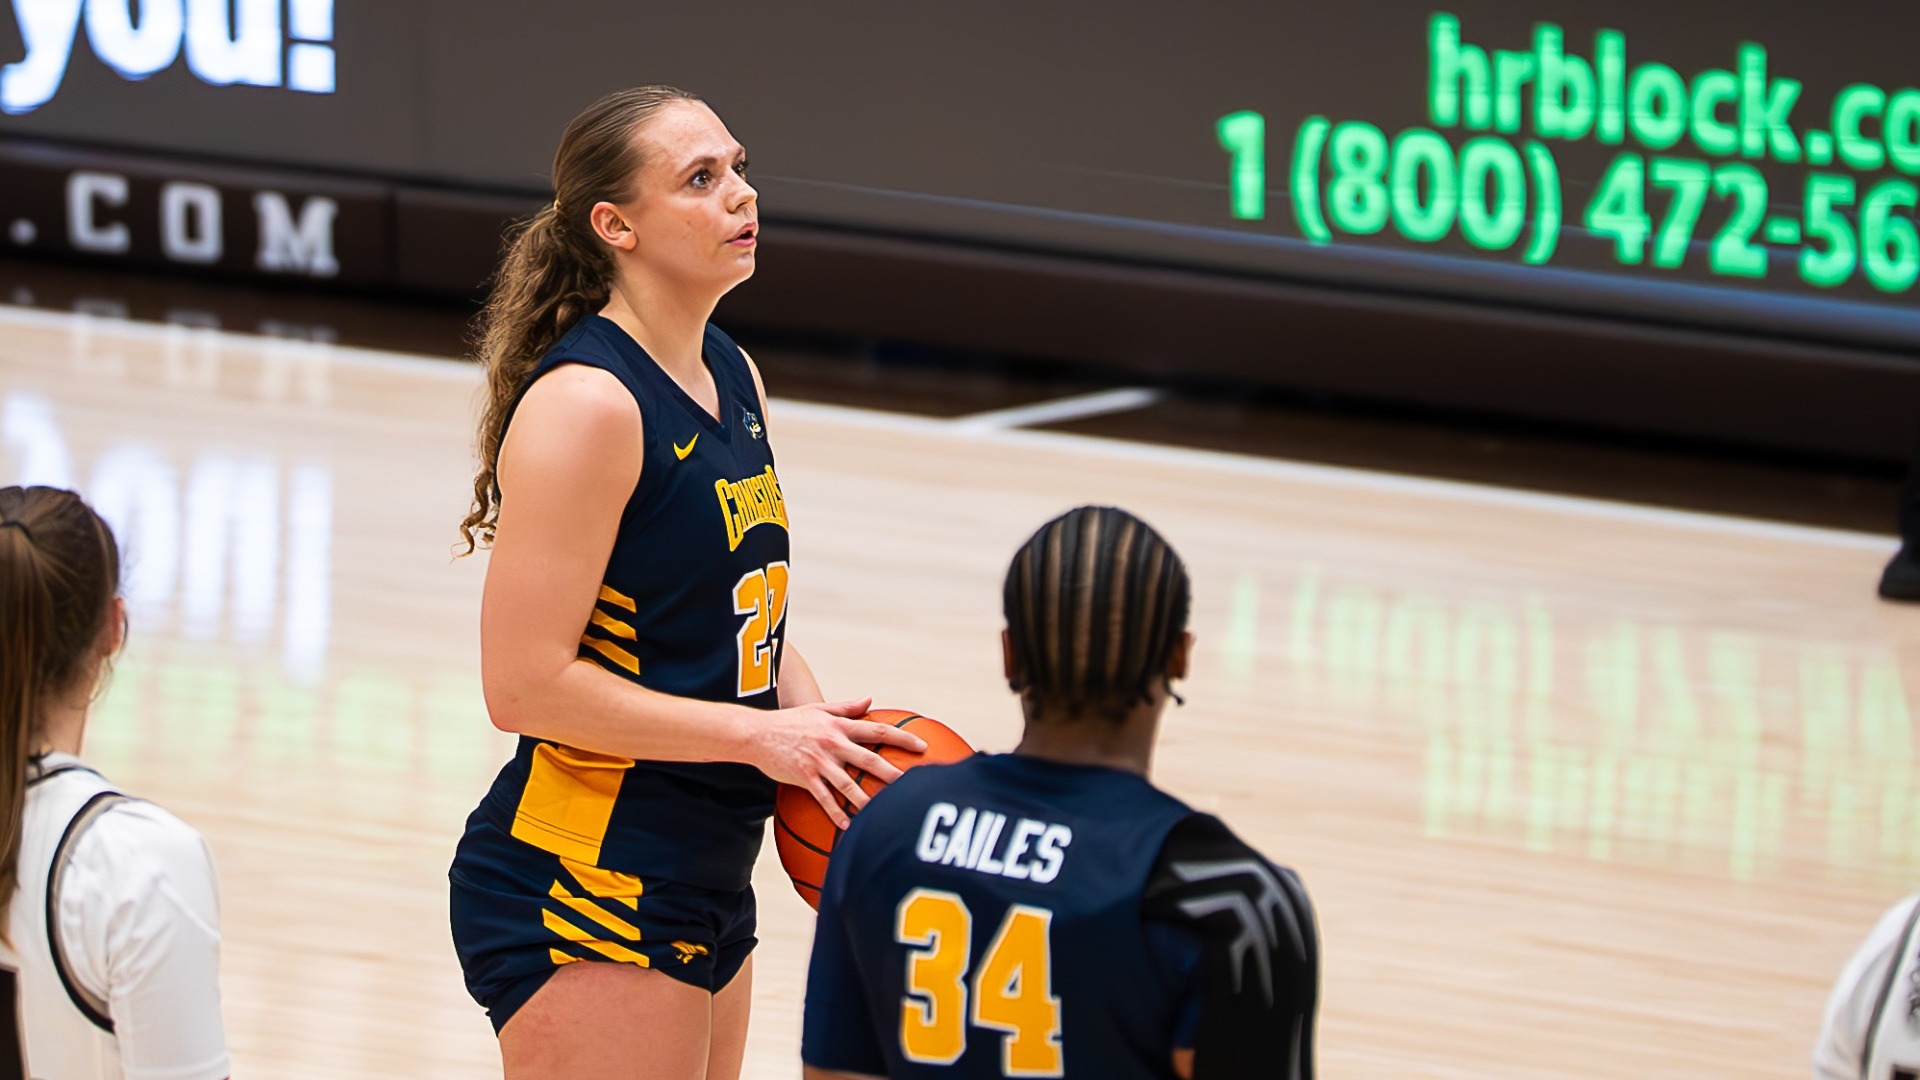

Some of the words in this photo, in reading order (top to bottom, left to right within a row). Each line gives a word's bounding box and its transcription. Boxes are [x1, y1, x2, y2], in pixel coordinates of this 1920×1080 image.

[1216, 110, 1266, 221] 1
[1290, 115, 1563, 266] (800)
[1584, 152, 1920, 293] 472-56
[915, 802, 1073, 884] GAILES
[895, 886, 1064, 1078] 34
